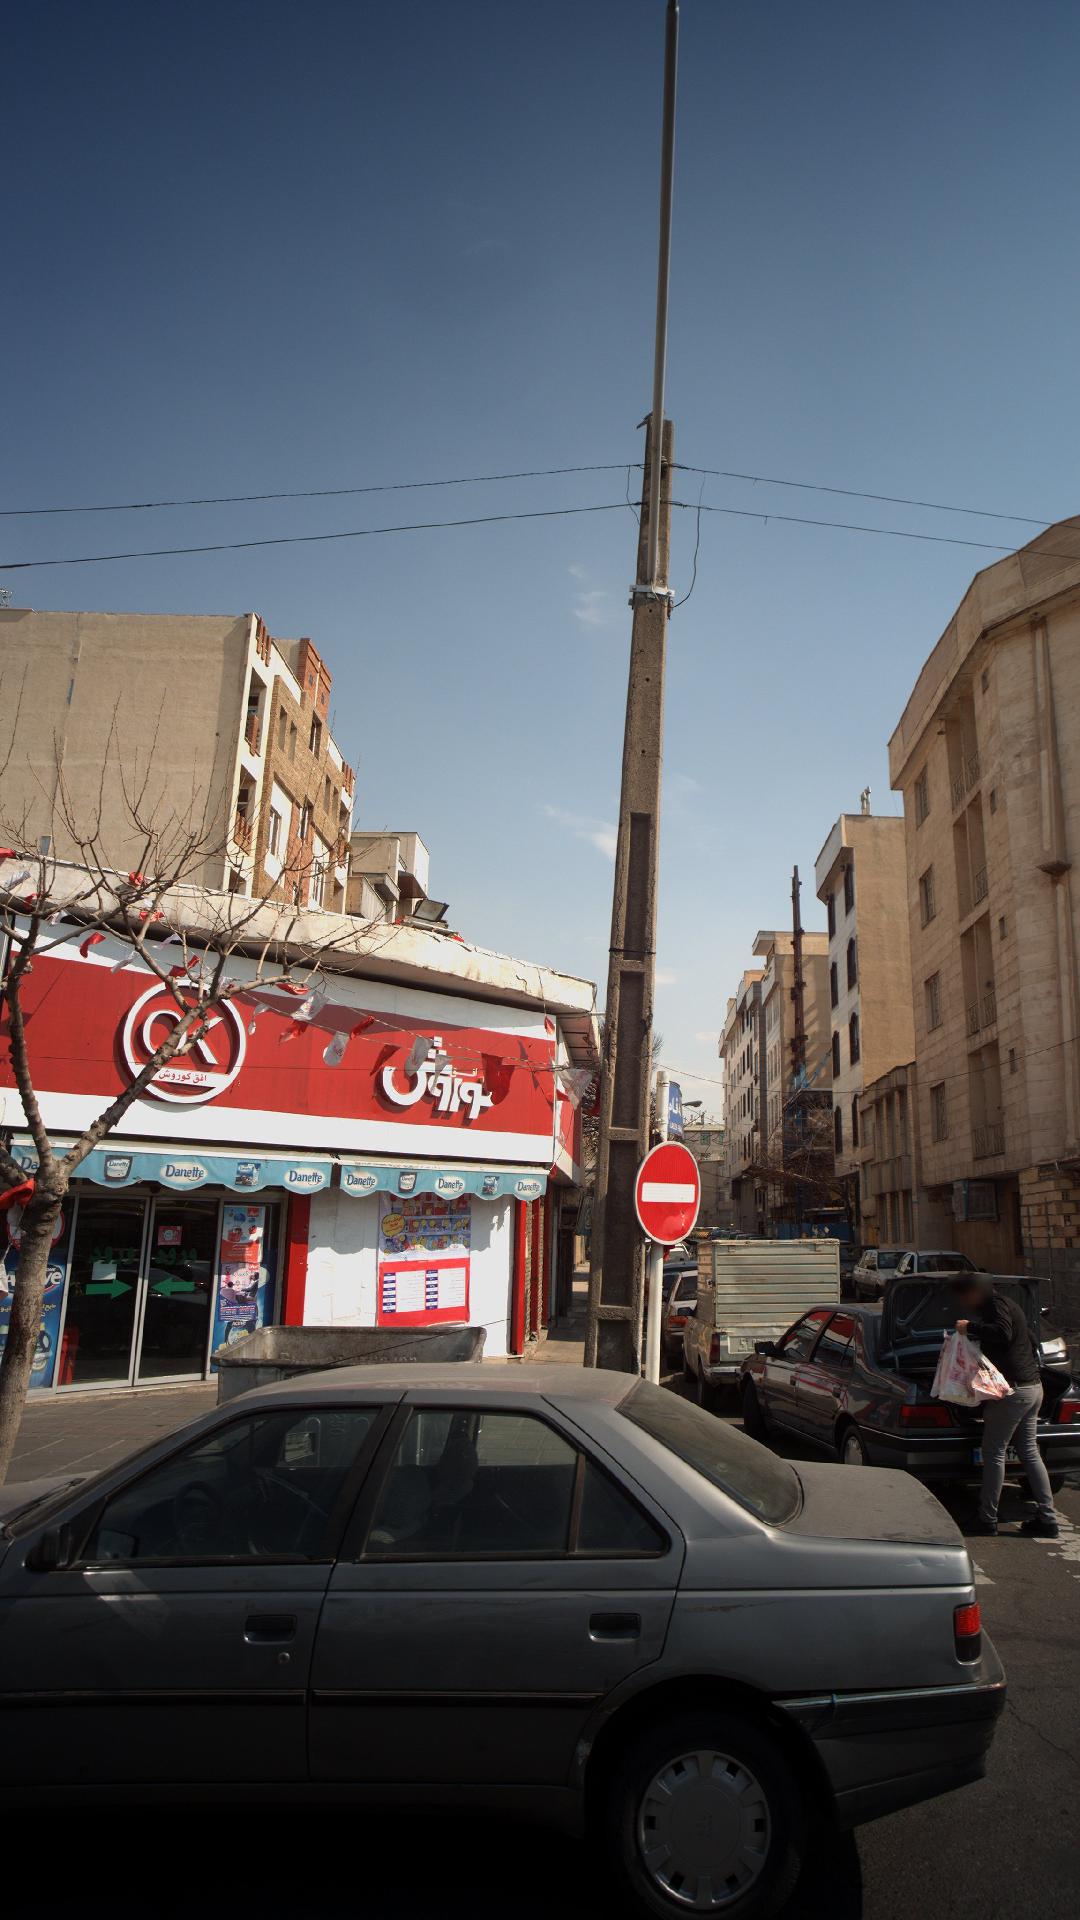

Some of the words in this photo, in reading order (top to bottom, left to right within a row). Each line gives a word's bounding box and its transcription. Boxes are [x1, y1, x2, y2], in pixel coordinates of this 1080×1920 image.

[165, 1164, 205, 1181] Danette
[289, 1170, 323, 1185] Danette
[347, 1174, 376, 1187] Danette
[438, 1178, 464, 1190] Danette
[517, 1182, 541, 1193] Danette
